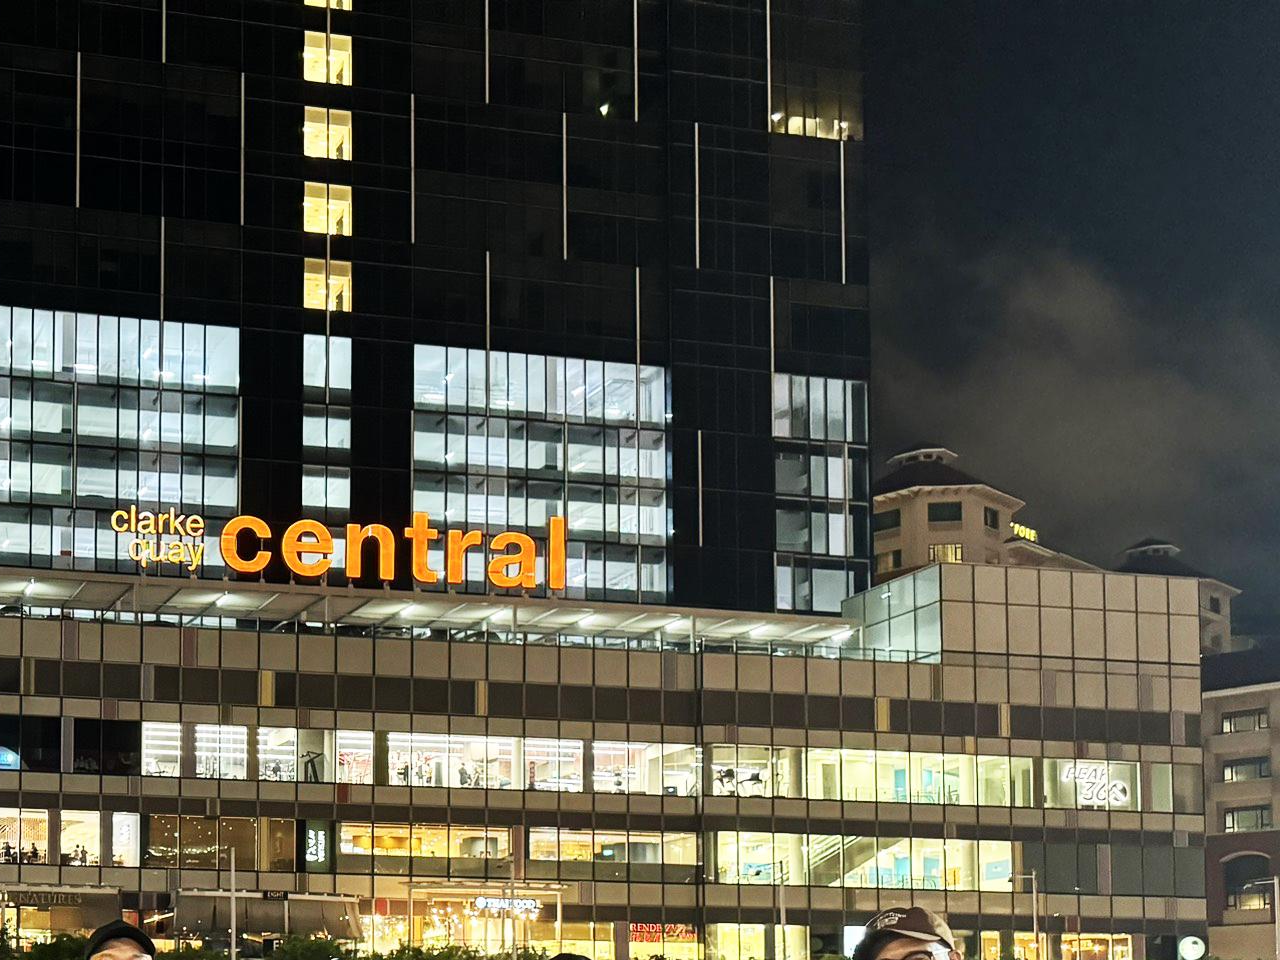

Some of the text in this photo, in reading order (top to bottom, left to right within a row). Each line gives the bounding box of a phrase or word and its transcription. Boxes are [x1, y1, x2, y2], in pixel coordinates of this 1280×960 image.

[110, 504, 205, 535] clarke
[128, 538, 205, 571] quay
[219, 511, 567, 590] central
